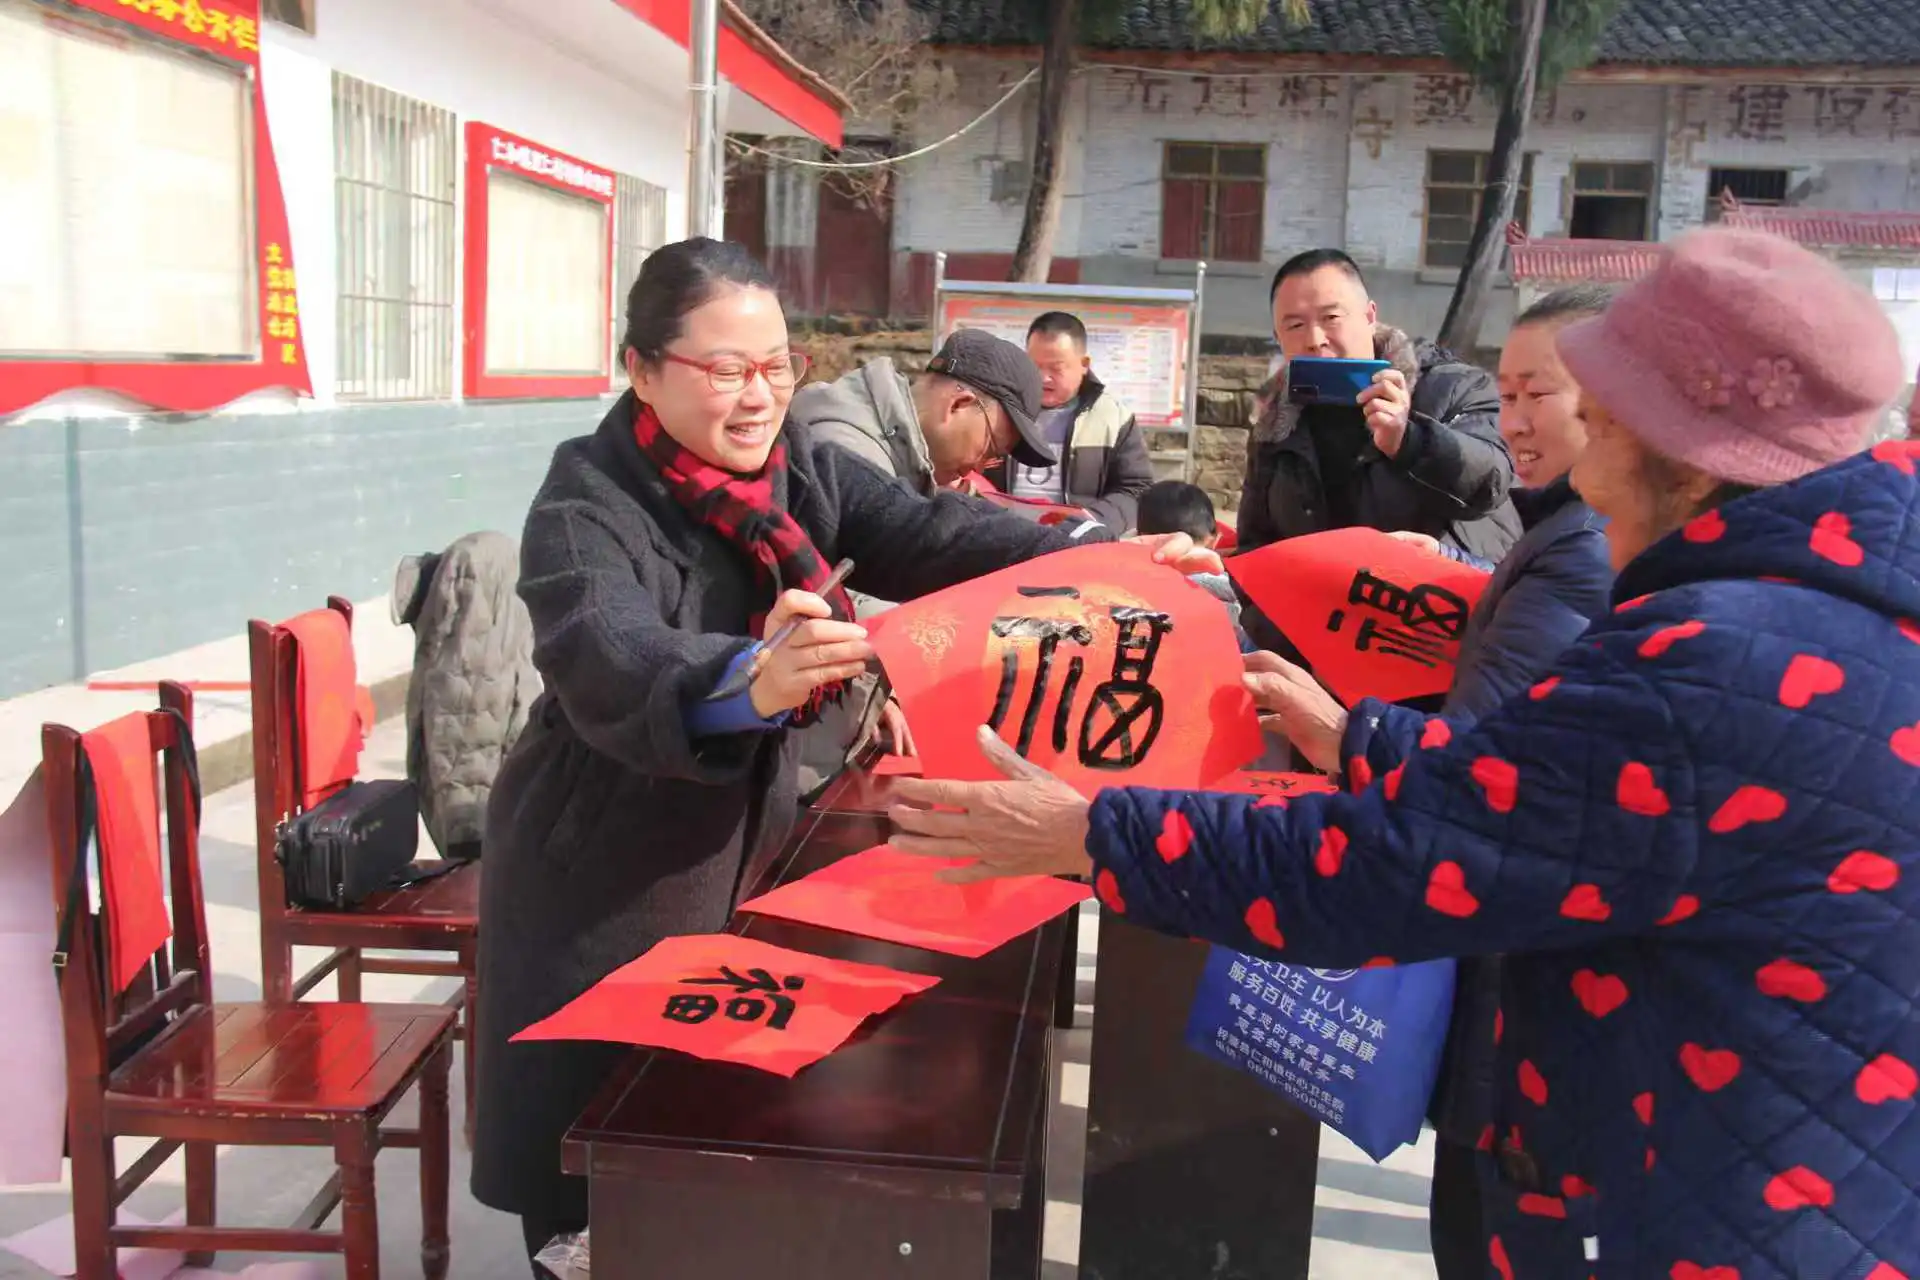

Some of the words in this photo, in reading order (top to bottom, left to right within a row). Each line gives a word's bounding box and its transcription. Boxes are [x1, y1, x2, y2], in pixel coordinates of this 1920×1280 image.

[1228, 961, 1297, 1018] 服务百姓
[1298, 1008, 1380, 1064] 共享健康
[1311, 985, 1387, 1039] 以人为本
